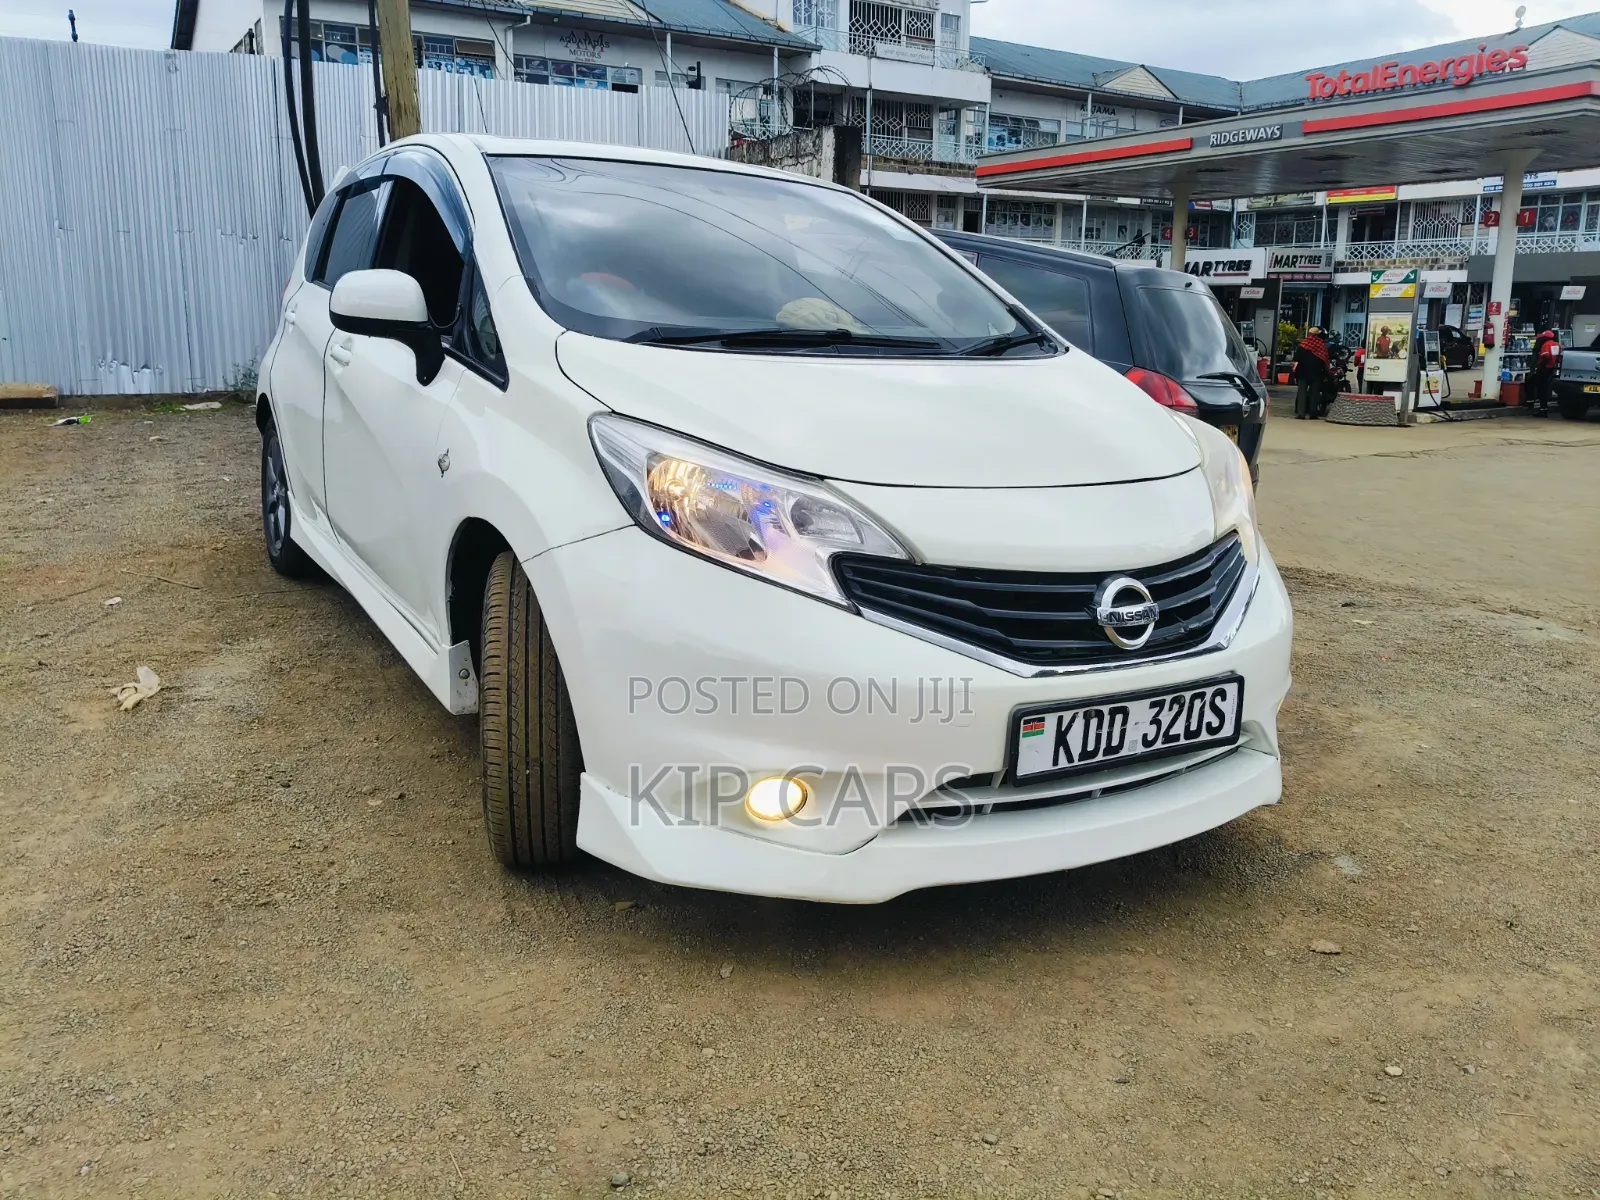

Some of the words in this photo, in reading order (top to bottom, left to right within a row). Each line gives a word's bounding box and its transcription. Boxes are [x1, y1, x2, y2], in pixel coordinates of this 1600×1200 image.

[569, 48, 602, 59] MOTORS
[1305, 43, 1530, 100] TotalEnergies
[1080, 103, 1116, 116] KJAMA
[1209, 125, 1280, 146] RIDGEWAYS
[1488, 213, 1496, 225] 2
[1523, 211, 1531, 223] 1
[1163, 228, 1171, 239] 4
[1188, 228, 1195, 238] 3
[1491, 302, 1498, 310] 2
[1107, 606, 1159, 624] NISSAN
[1052, 705, 1130, 768] KDD
[1141, 687, 1228, 749] 320S
